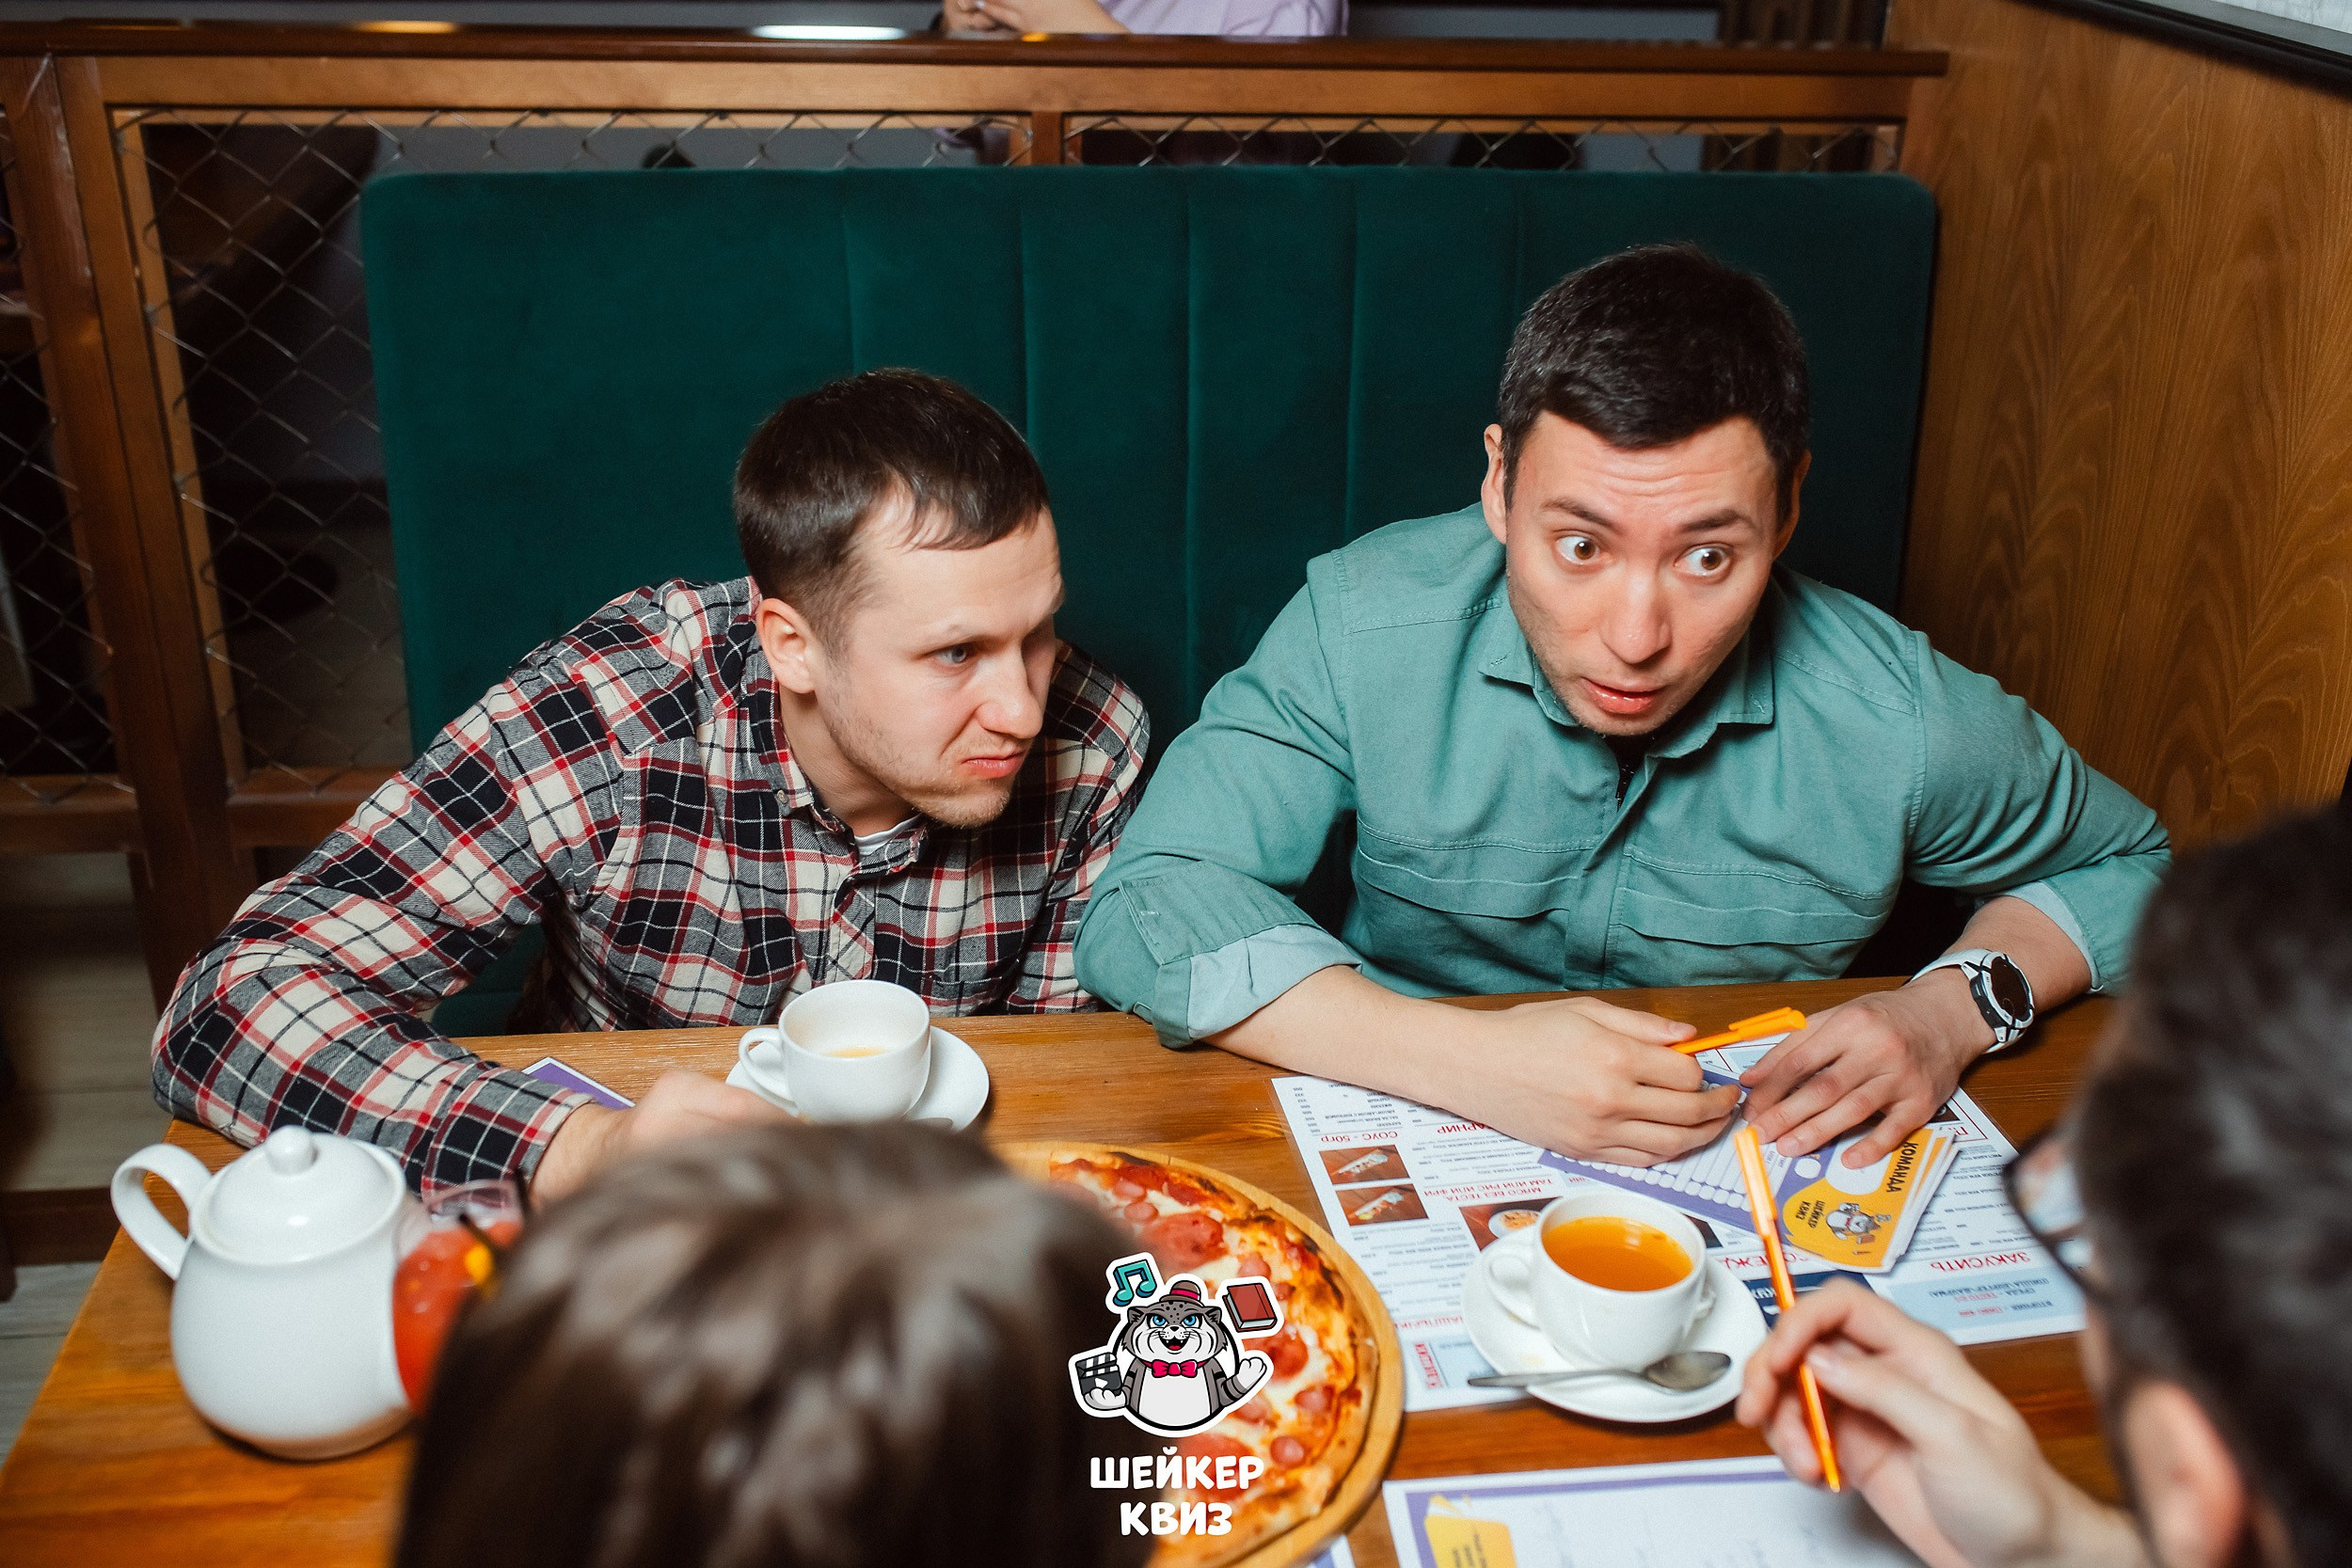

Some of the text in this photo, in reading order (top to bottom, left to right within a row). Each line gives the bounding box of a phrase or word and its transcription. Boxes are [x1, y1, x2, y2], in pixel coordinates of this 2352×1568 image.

[1437, 1122, 1493, 1134] АРНИР
[1321, 1134, 1351, 1143] 50гр
[1361, 1131, 1398, 1141] СОУС
[1886, 1142, 1919, 1193] КОМАНДА
[1502, 1180, 1527, 1189] ИЛИ
[1529, 1179, 1553, 1187] ТАМ
[1423, 1188, 1449, 1196] ФРИ
[1451, 1185, 1474, 1194] ИЛИ
[1484, 1190, 1505, 1198] БЕЗ
[1507, 1187, 1542, 1196] МЯСО
[1931, 1252, 2030, 1272] ЗАКУСИТЬ
